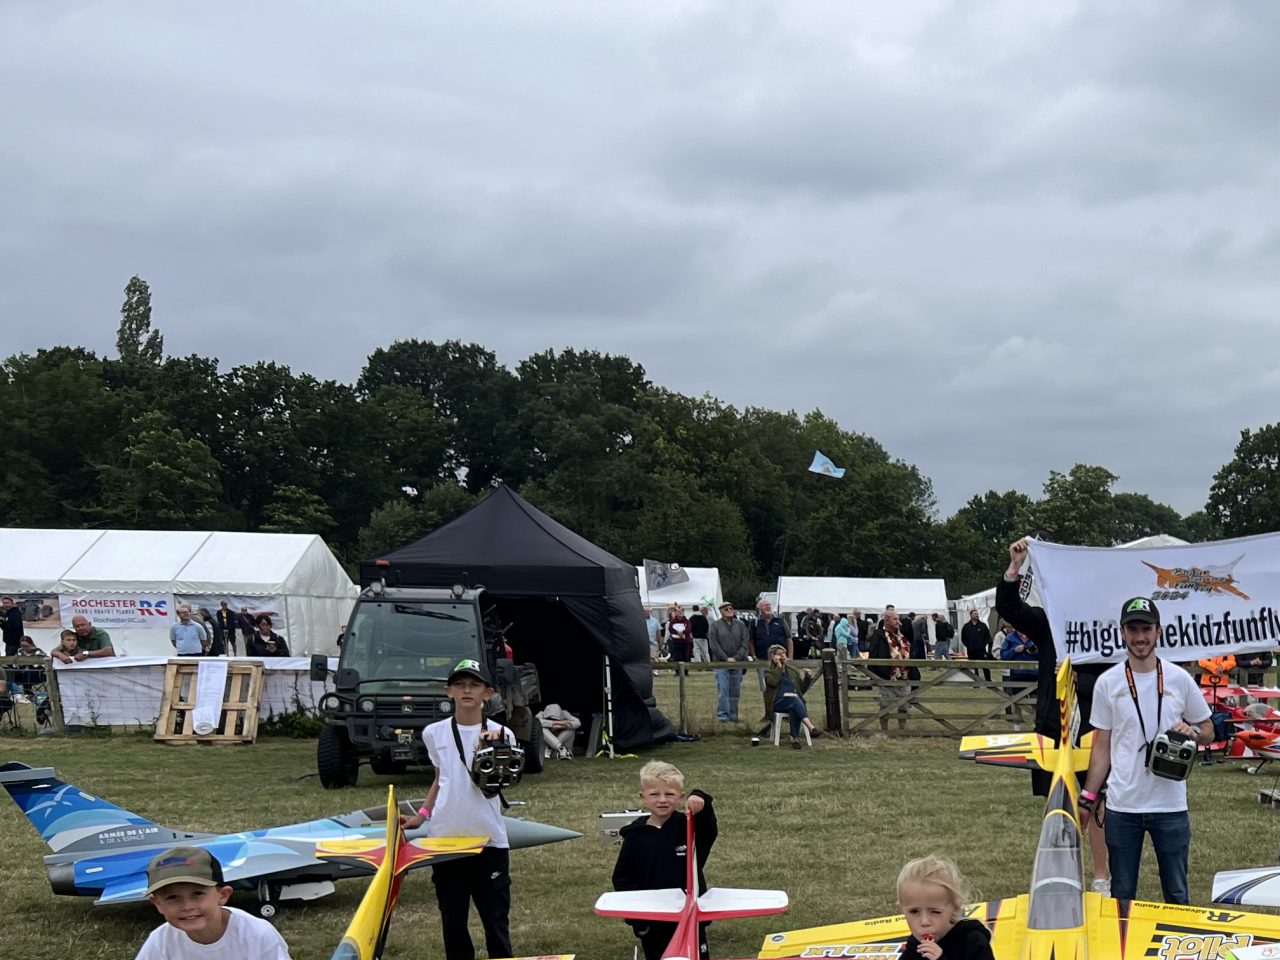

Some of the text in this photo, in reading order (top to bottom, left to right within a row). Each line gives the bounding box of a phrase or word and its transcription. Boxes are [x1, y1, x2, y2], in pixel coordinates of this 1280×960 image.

[72, 599, 136, 608] ROCHESTER
[137, 600, 168, 616] RC
[1127, 599, 1150, 612] AR
[99, 831, 125, 839] ARMÉE
[1162, 905, 1207, 914] Advanced
[1207, 910, 1245, 923] AR
